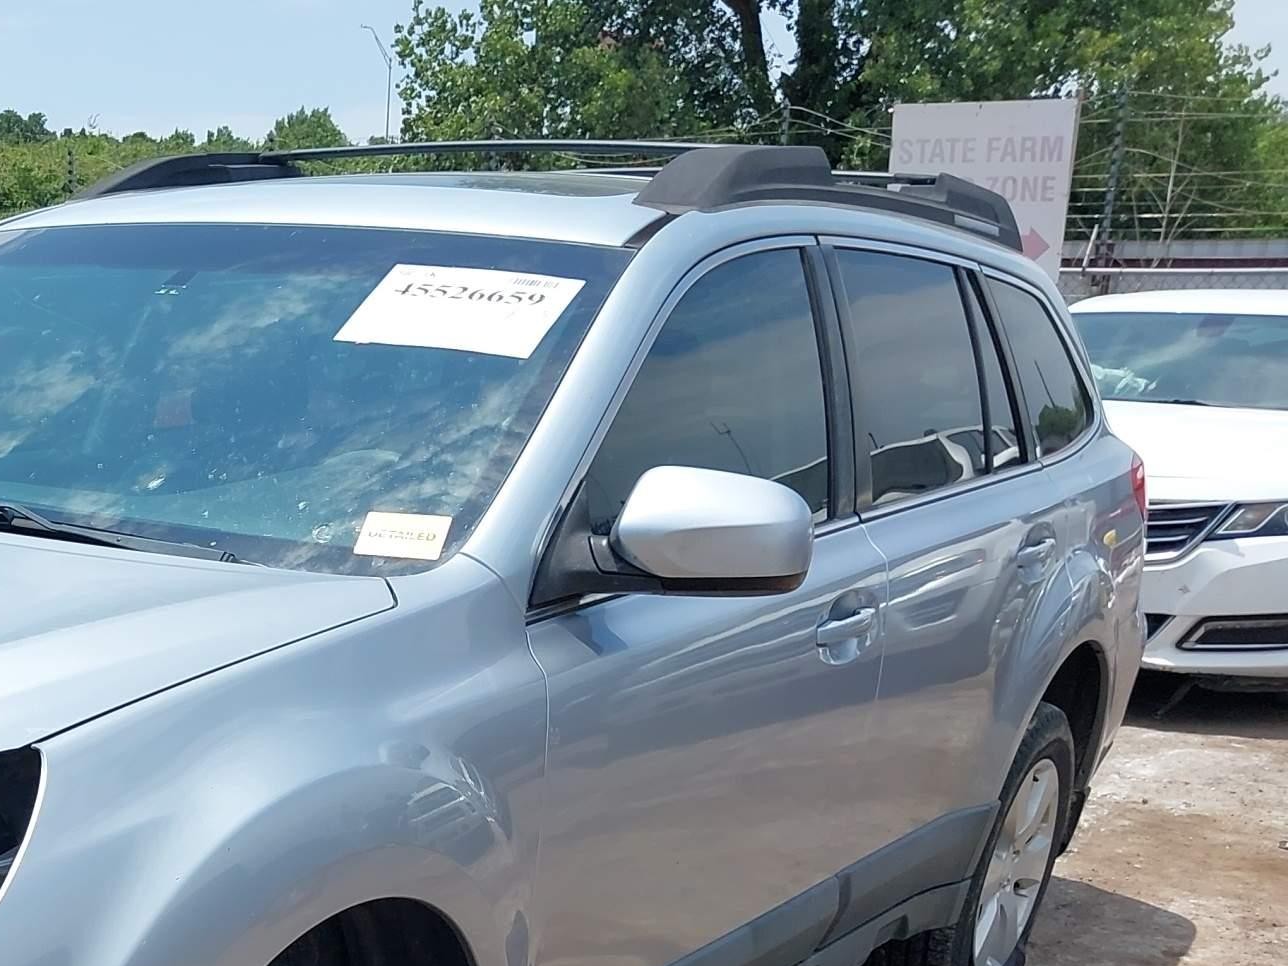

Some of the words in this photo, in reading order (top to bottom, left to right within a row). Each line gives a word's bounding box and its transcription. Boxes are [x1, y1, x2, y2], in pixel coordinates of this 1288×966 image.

[898, 137, 977, 165] STATE
[985, 135, 1065, 163] FARM
[394, 282, 546, 306] 45526659
